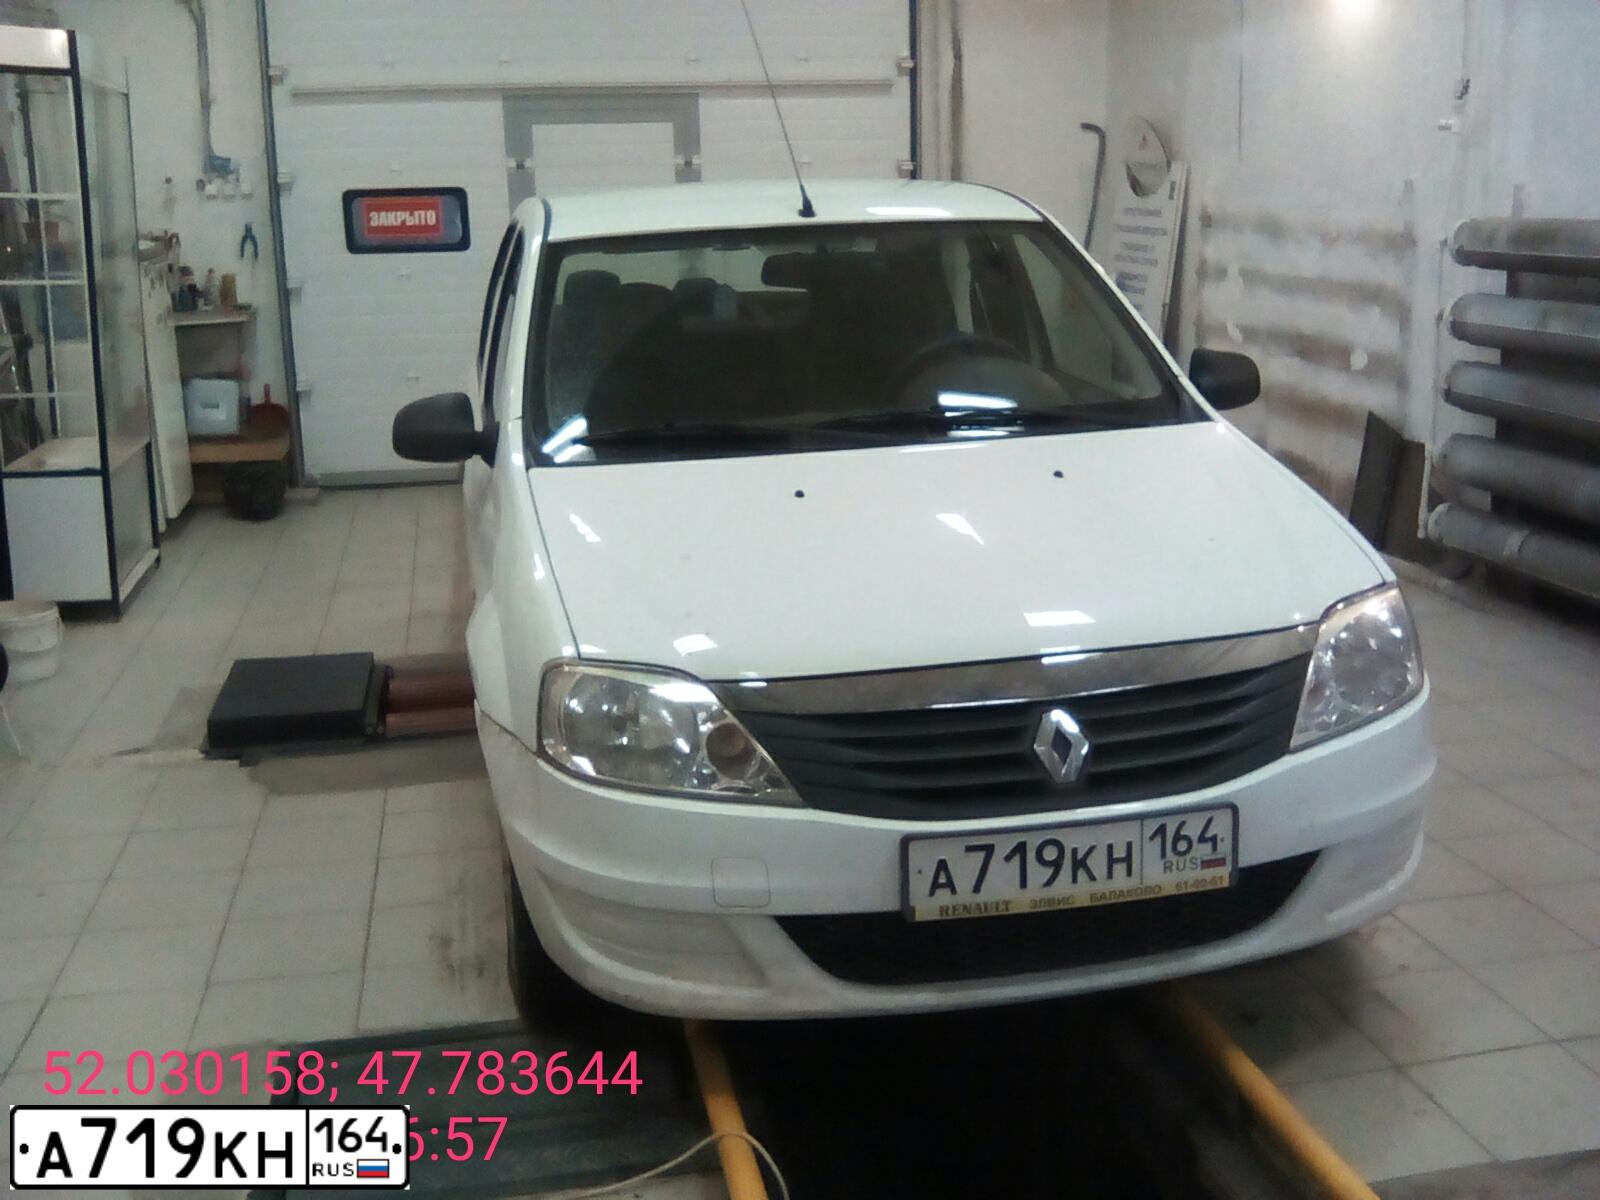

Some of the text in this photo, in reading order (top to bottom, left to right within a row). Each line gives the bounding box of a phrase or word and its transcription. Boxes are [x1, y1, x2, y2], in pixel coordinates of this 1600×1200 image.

[369, 209, 437, 227] ЗАКРЫТО
[1149, 815, 1220, 860] 164
[1163, 856, 1199, 875] RUS
[938, 899, 1013, 918] RENAULT
[1089, 883, 1163, 904] БАЛАКОВО
